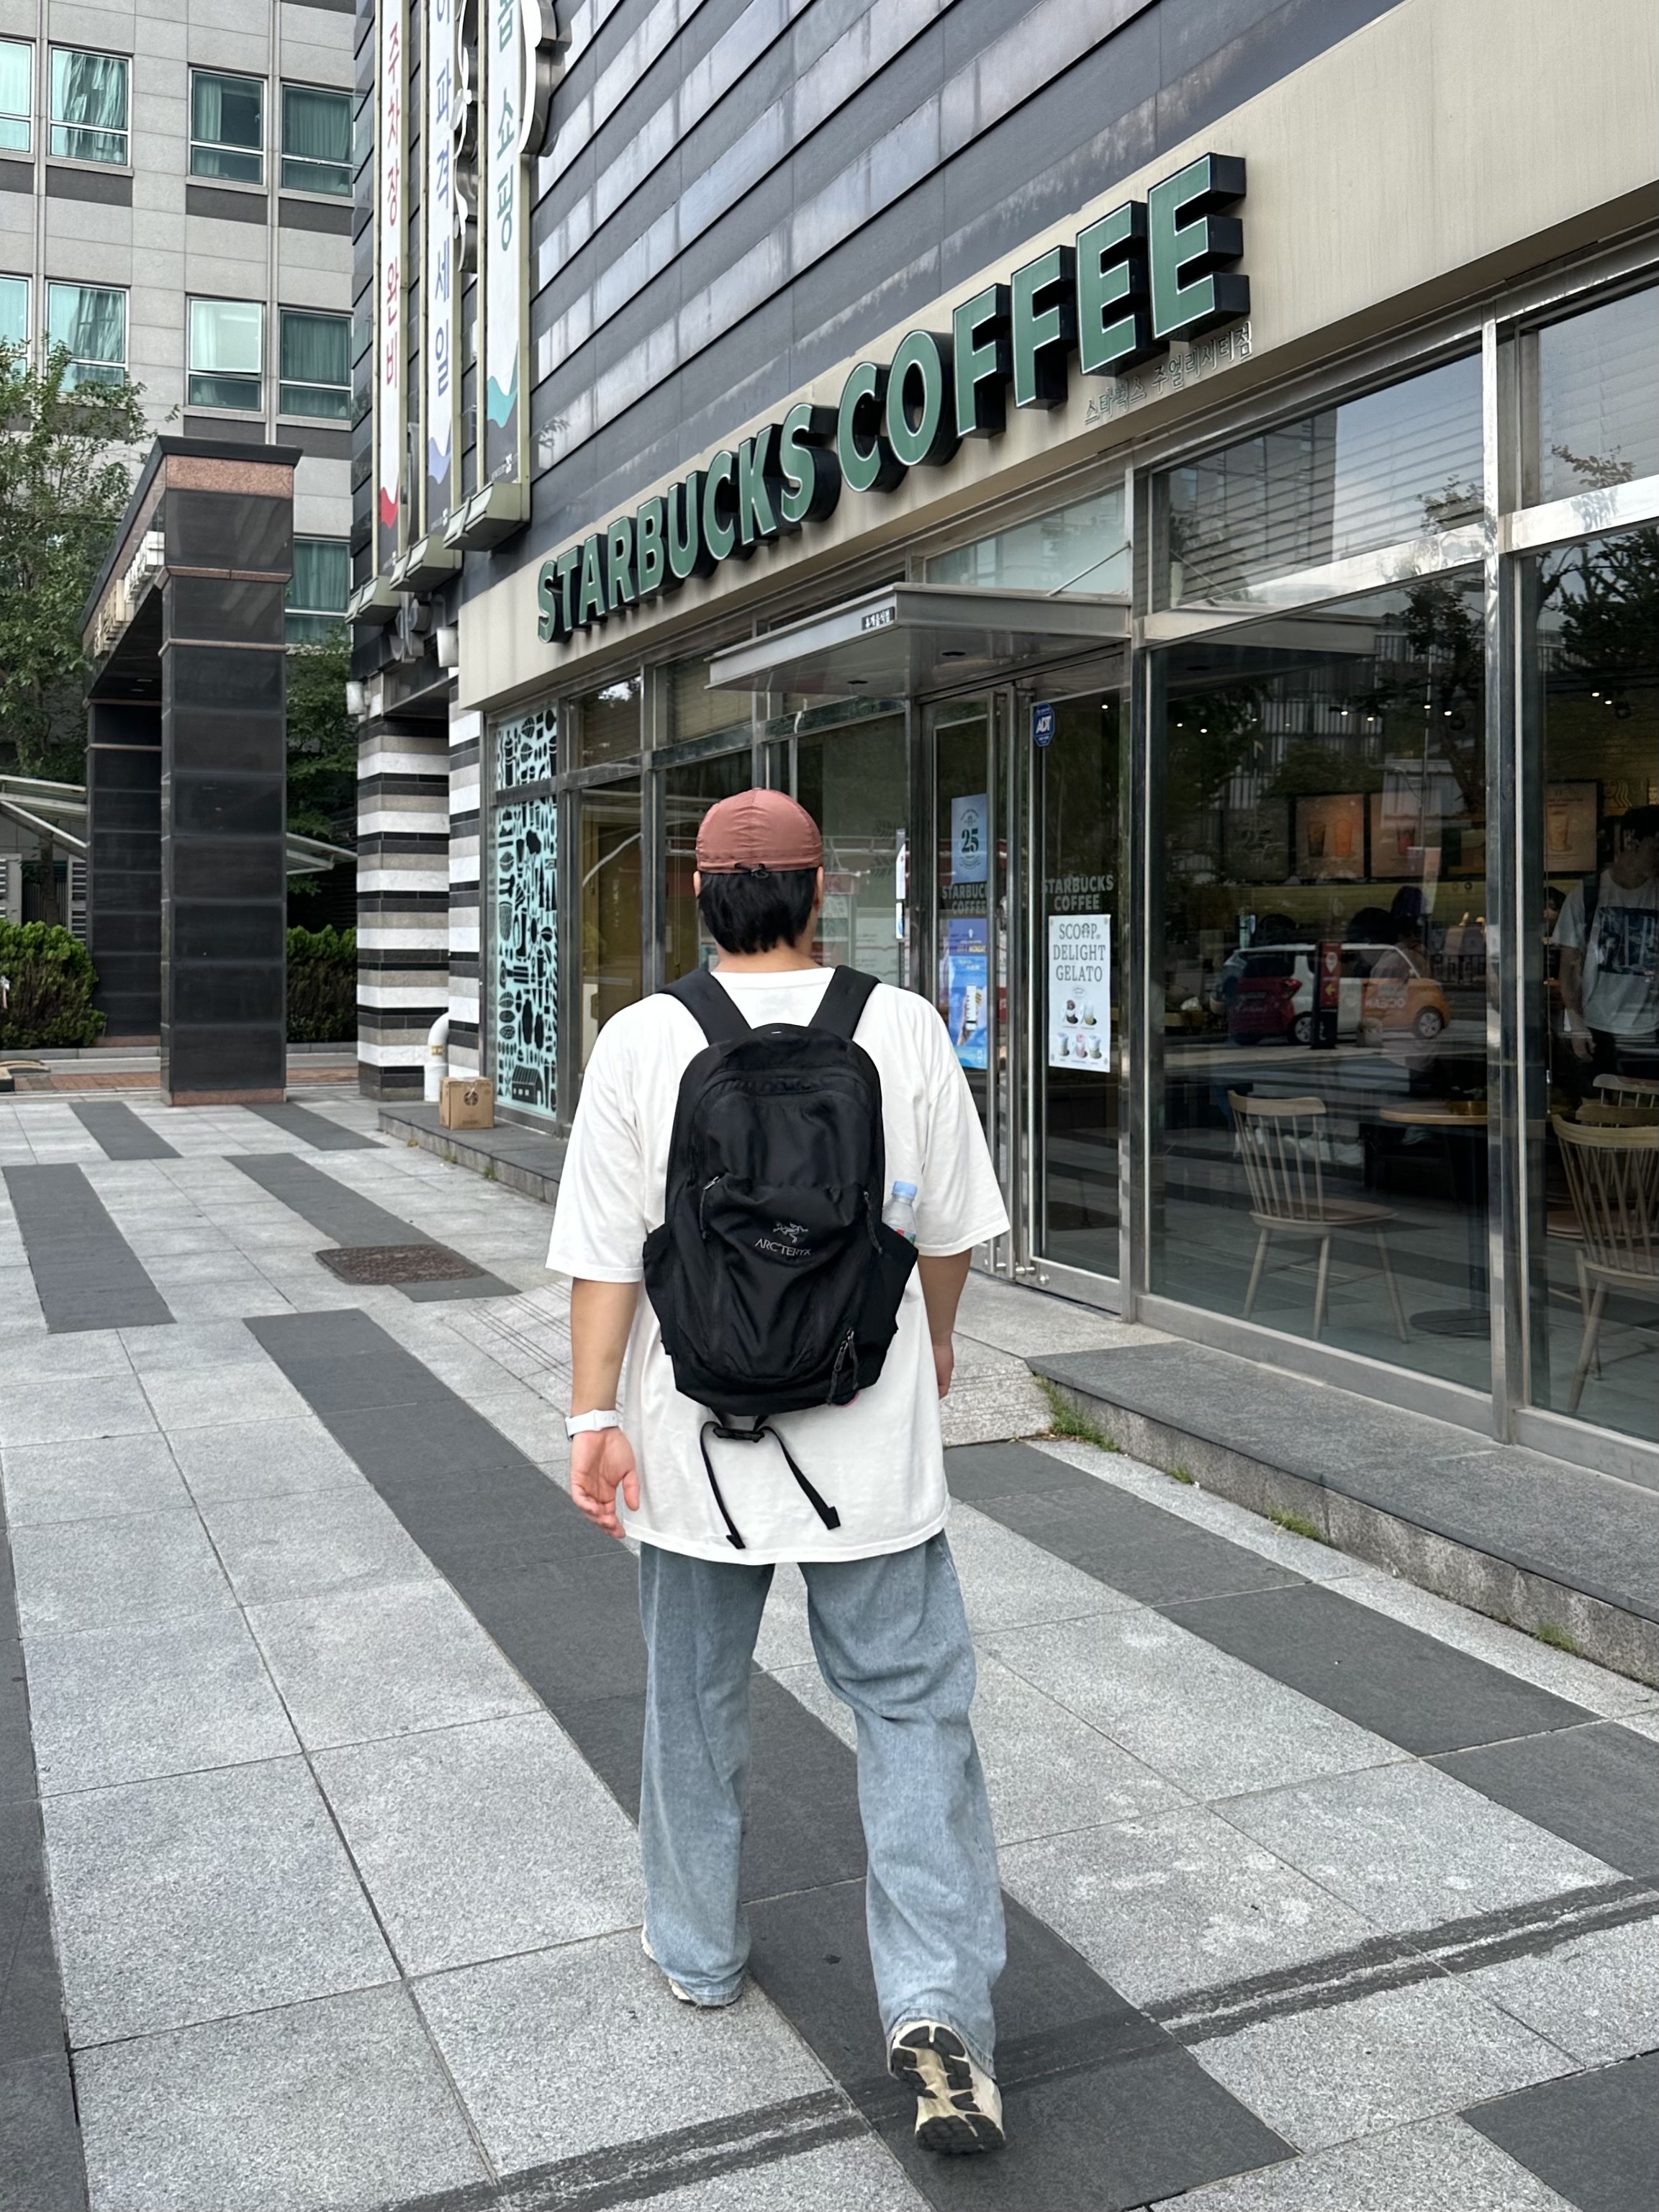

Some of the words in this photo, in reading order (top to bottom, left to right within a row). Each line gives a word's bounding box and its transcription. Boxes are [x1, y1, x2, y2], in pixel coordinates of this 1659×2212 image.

[387, 21, 400, 227] 주차장
[436, 58, 451, 210] 파격
[497, 87, 515, 251] 쇼핑
[387, 256, 399, 389] 완비
[435, 235, 450, 397] 세일
[538, 403, 819, 644] STARBUCKS
[837, 154, 1220, 492] COFFEE
[1084, 376, 1147, 425] 스타벅스
[1152, 320, 1253, 395] 주얼리시티점
[1036, 715, 1052, 733] ADT
[961, 828, 980, 854] 25
[942, 883, 987, 900] STARBUC
[1041, 875, 1114, 894] STARBUCKS
[1054, 893, 1100, 912] COFFEE
[1053, 944, 1106, 961] DELIGHT
[1055, 965, 1103, 983] GELATO
